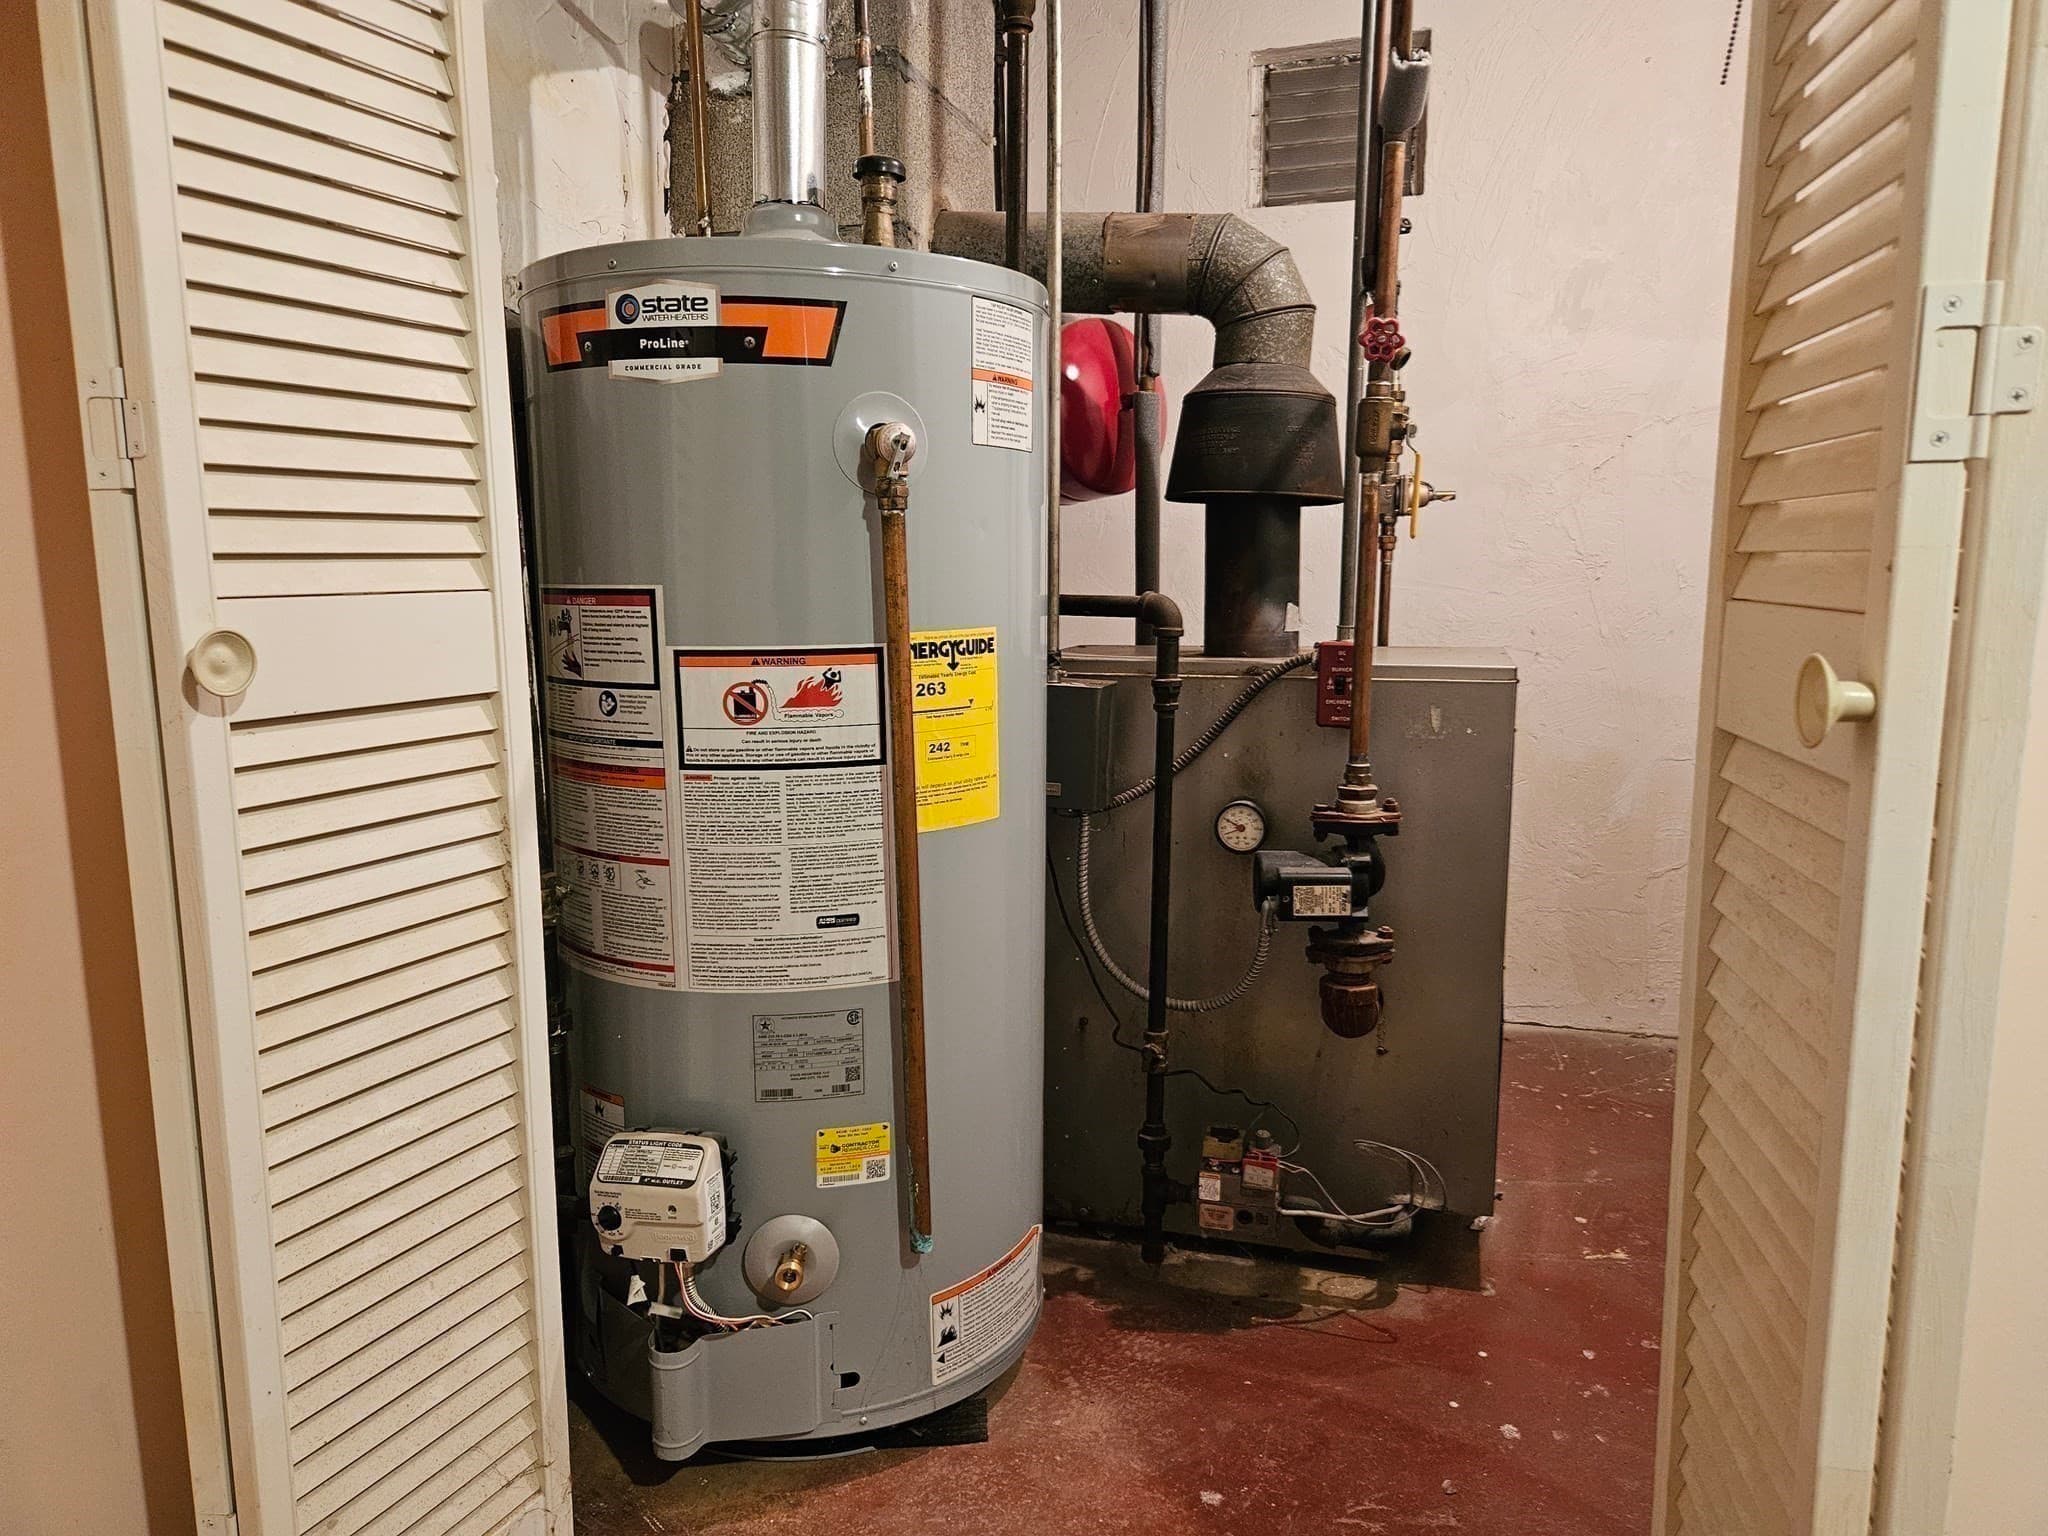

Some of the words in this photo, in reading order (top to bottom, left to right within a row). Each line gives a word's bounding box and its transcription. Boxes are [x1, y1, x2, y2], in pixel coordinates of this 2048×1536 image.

[642, 295, 708, 313] state
[642, 314, 670, 322] WATER
[670, 313, 709, 321] HEATERS
[640, 338, 685, 349] ProLine
[573, 597, 597, 605] DANGER
[761, 657, 806, 665] WARNING
[915, 681, 946, 697] 263
[928, 742, 951, 754] 242
